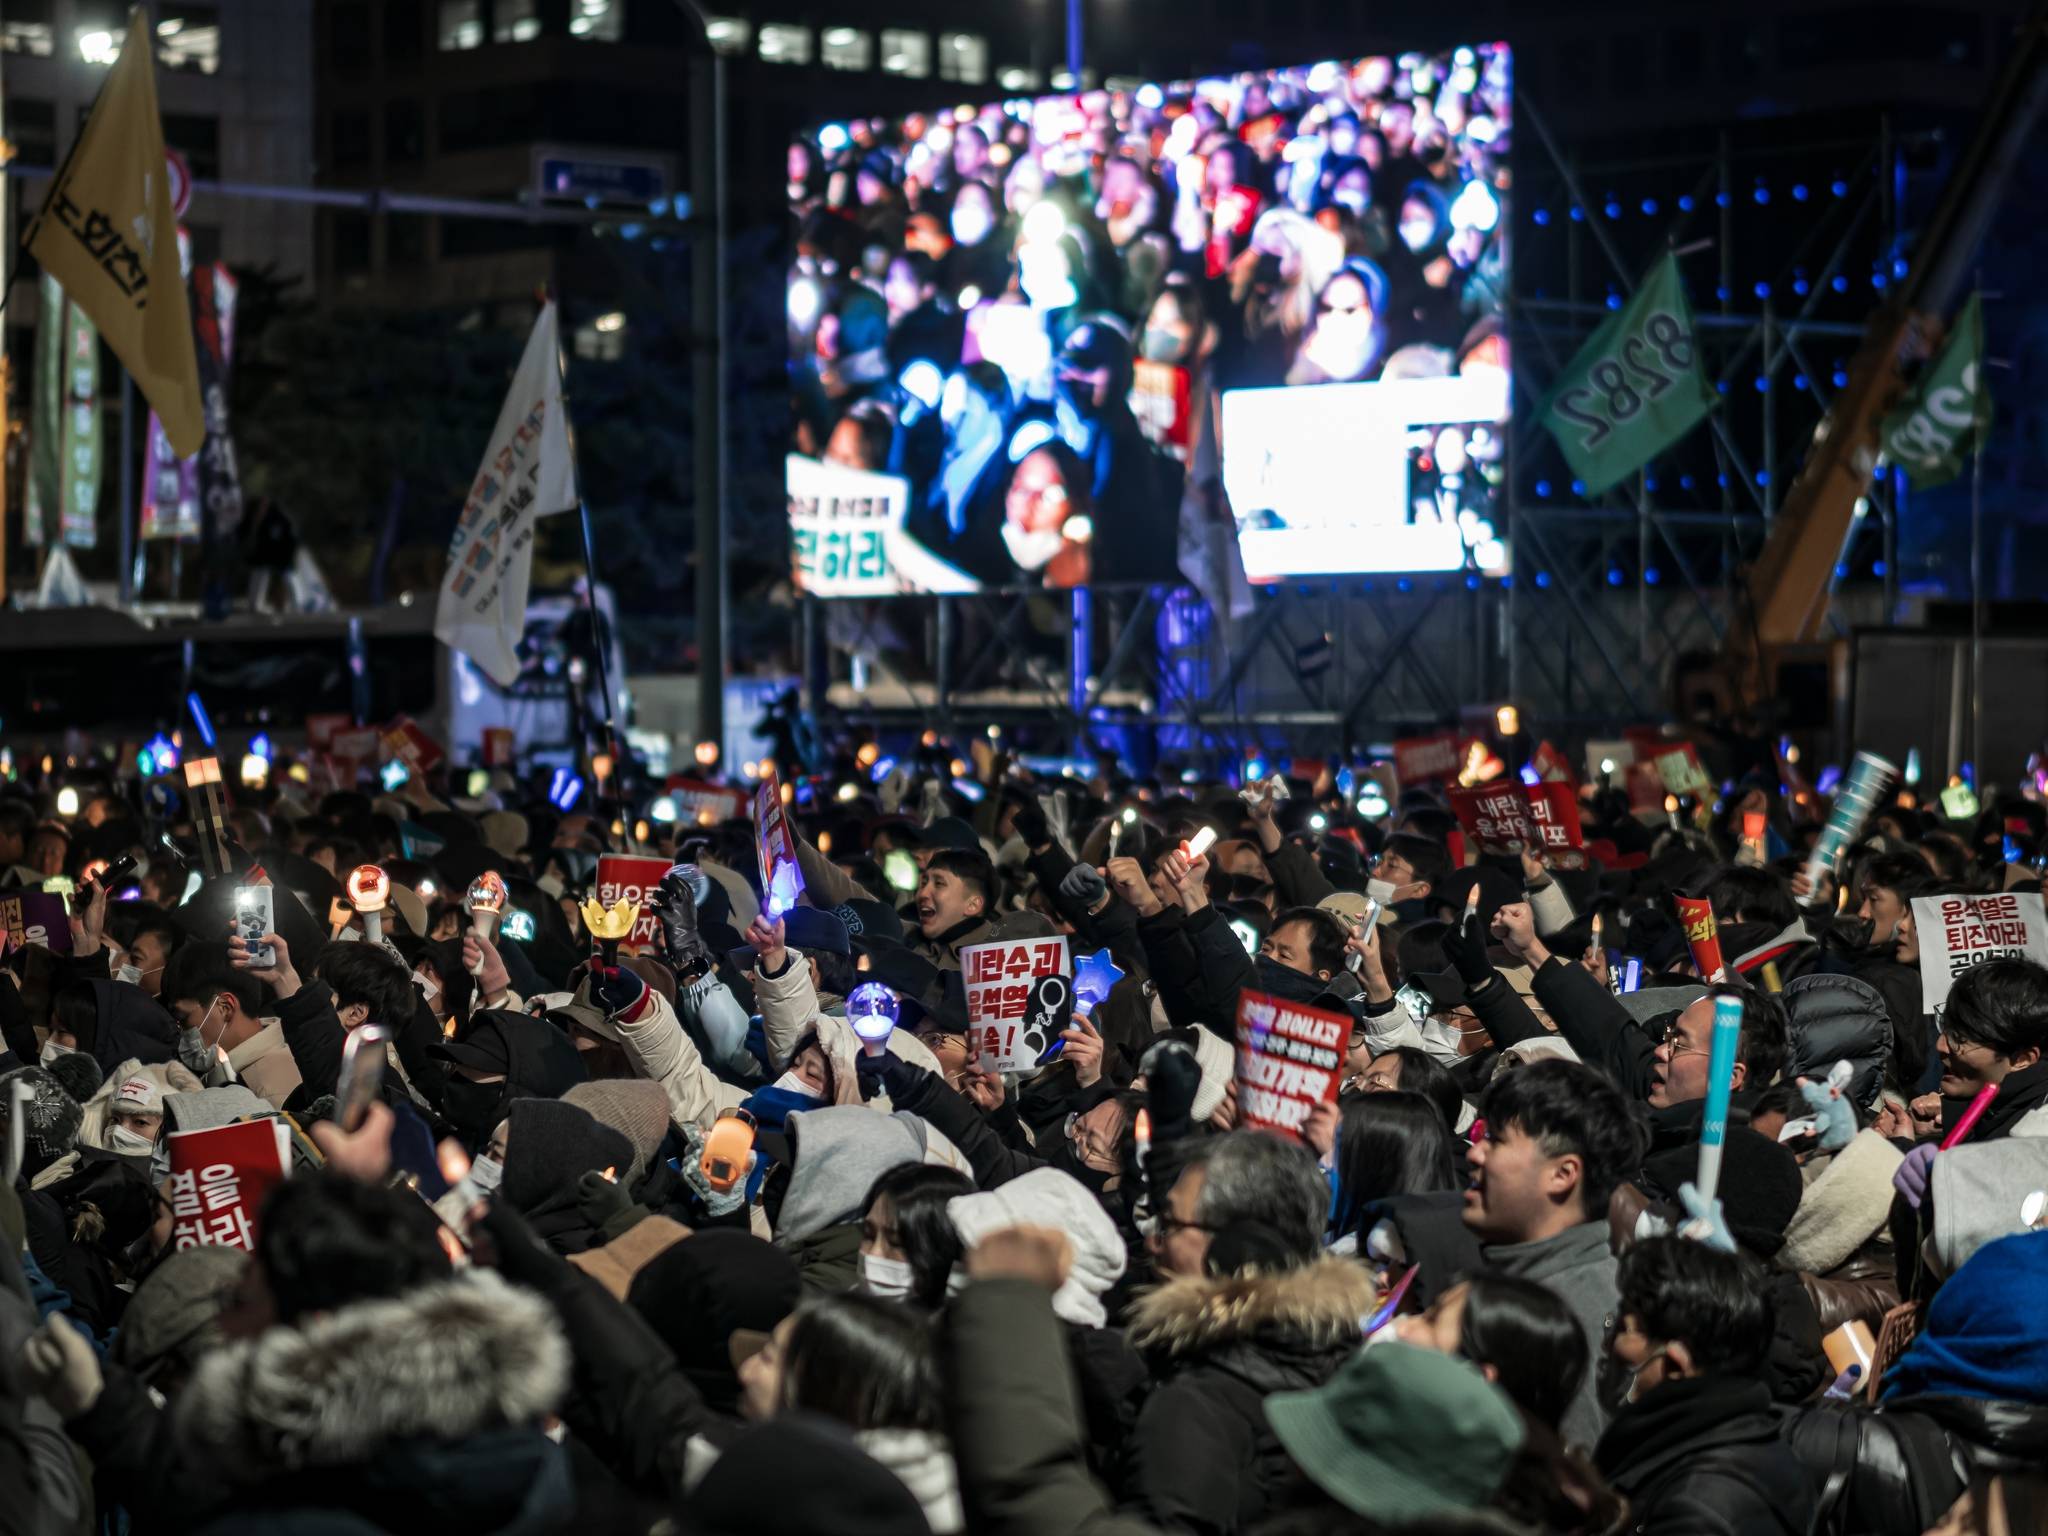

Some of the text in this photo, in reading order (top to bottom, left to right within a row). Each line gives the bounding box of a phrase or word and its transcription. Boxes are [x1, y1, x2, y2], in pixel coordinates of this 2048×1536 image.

[1476, 795, 1552, 823] 내란괴
[1941, 895, 2019, 926] 윤석열은
[968, 985, 1028, 1022] 윤석열
